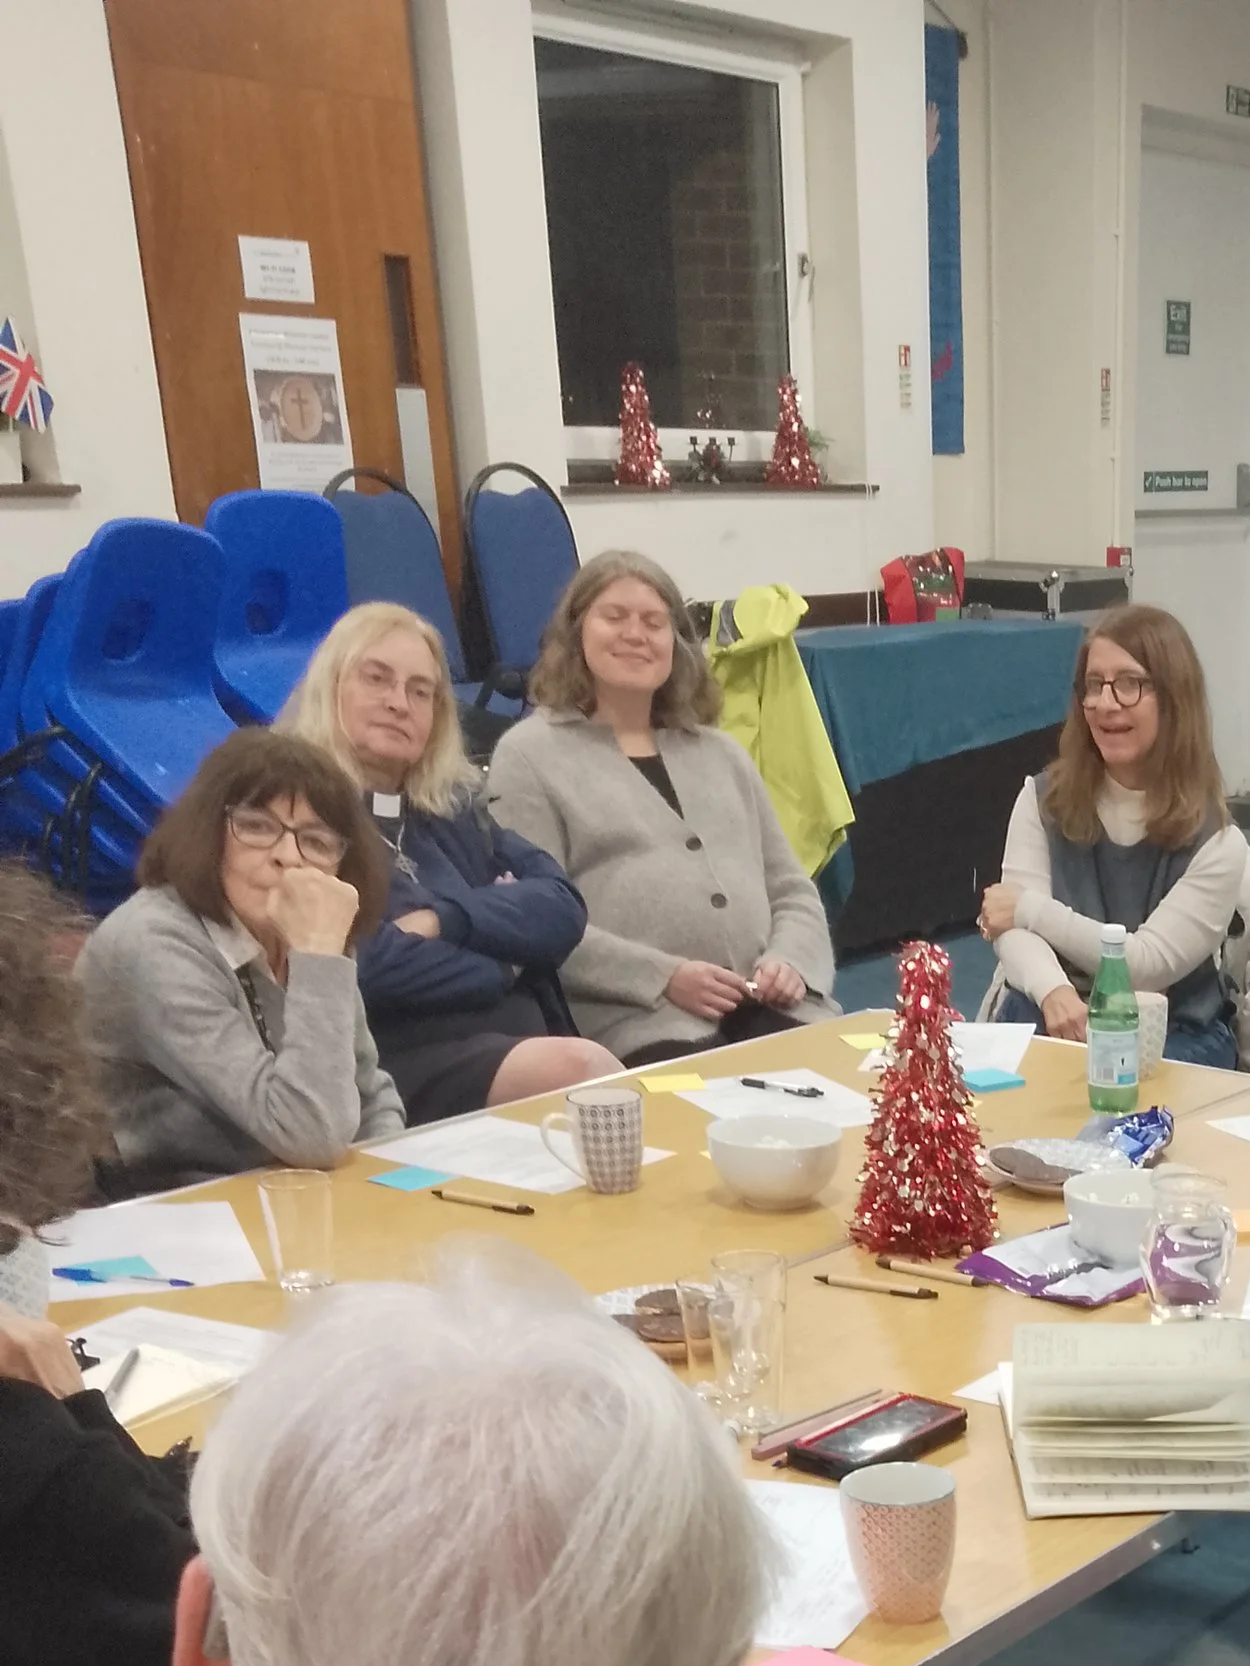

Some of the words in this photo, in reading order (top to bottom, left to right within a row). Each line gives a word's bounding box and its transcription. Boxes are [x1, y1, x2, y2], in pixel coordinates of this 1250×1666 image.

[1155, 475, 1171, 487] Push
[1172, 475, 1183, 487] bar
[1184, 474, 1191, 487] to
[1191, 477, 1207, 489] open
